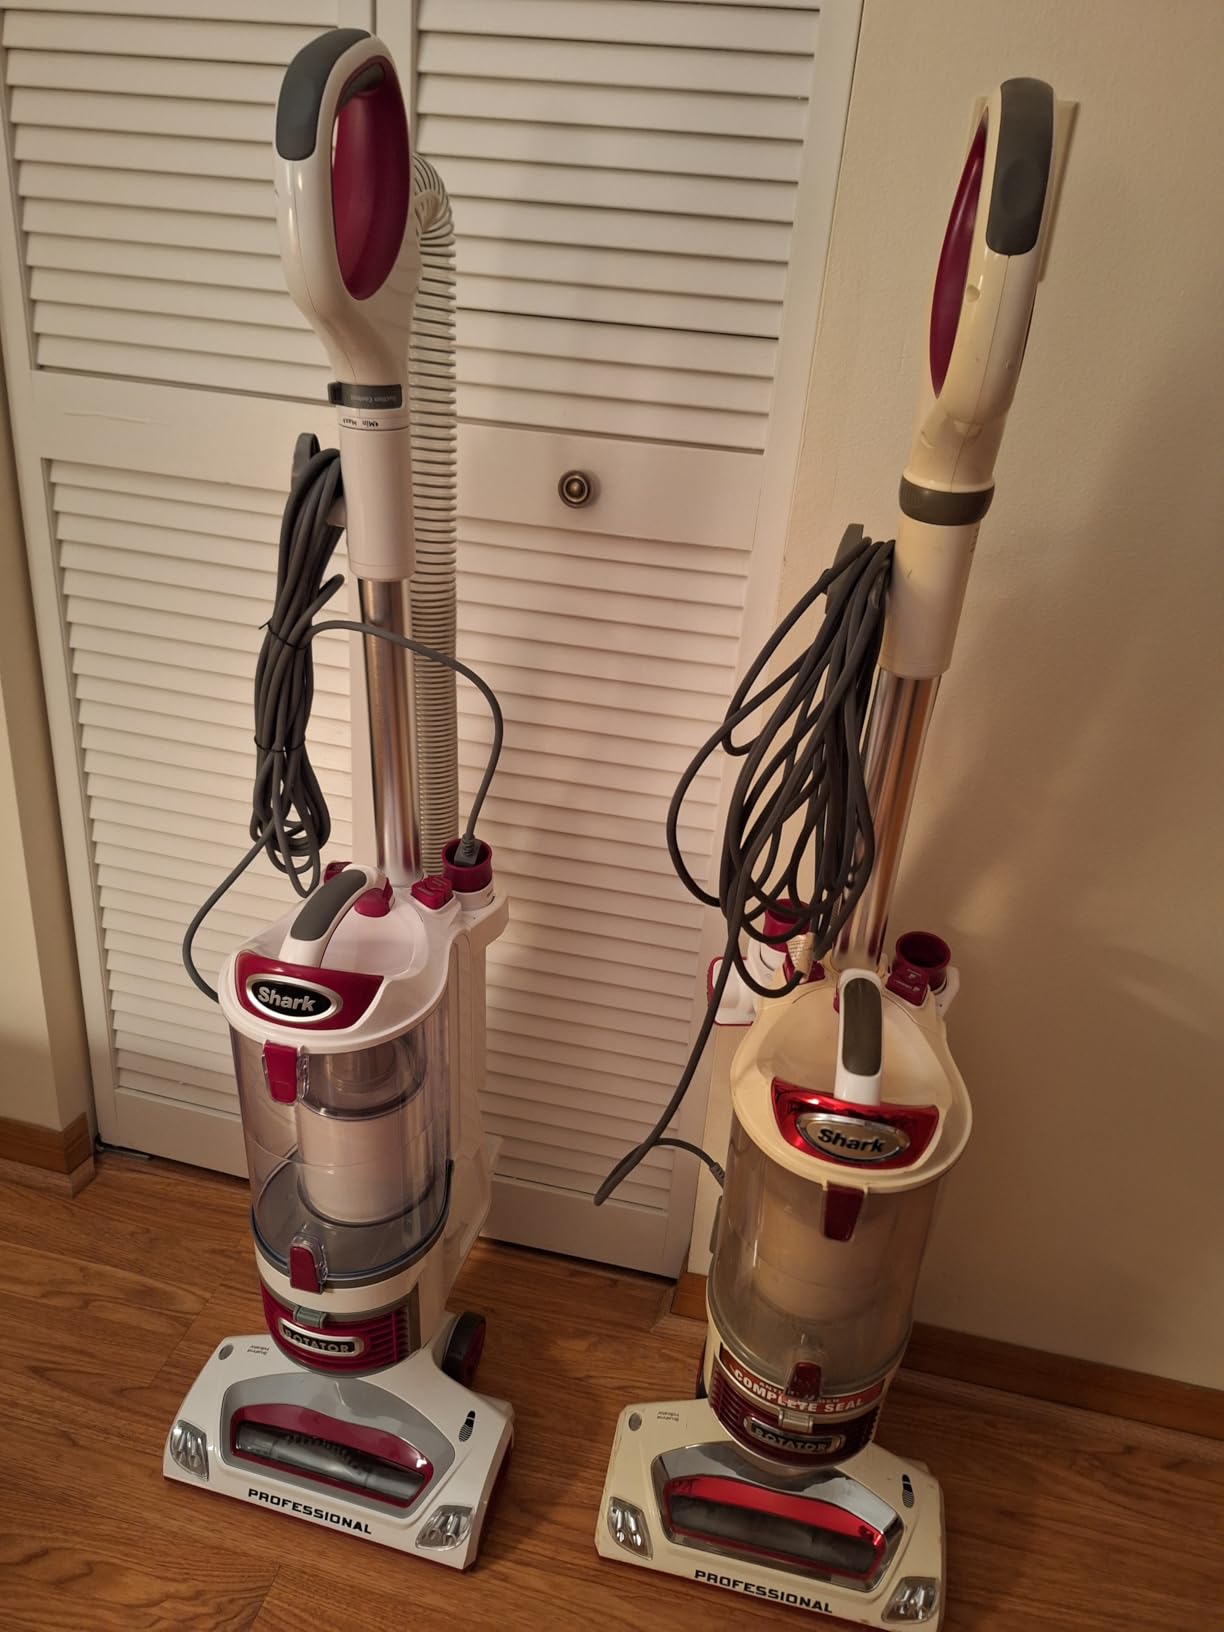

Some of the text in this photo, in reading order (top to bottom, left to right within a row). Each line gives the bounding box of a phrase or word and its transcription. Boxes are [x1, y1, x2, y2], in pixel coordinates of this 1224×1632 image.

[257, 986, 316, 1012] Shark
[817, 1128, 886, 1153] Shark
[284, 1327, 350, 1353] ROTATOR
[734, 1368, 864, 1413] COMPLETE SEAL
[754, 1426, 827, 1451] ROTATOR
[248, 1488, 372, 1535] PROFESSIONAL
[694, 1569, 833, 1614] PROFESSIONAL
